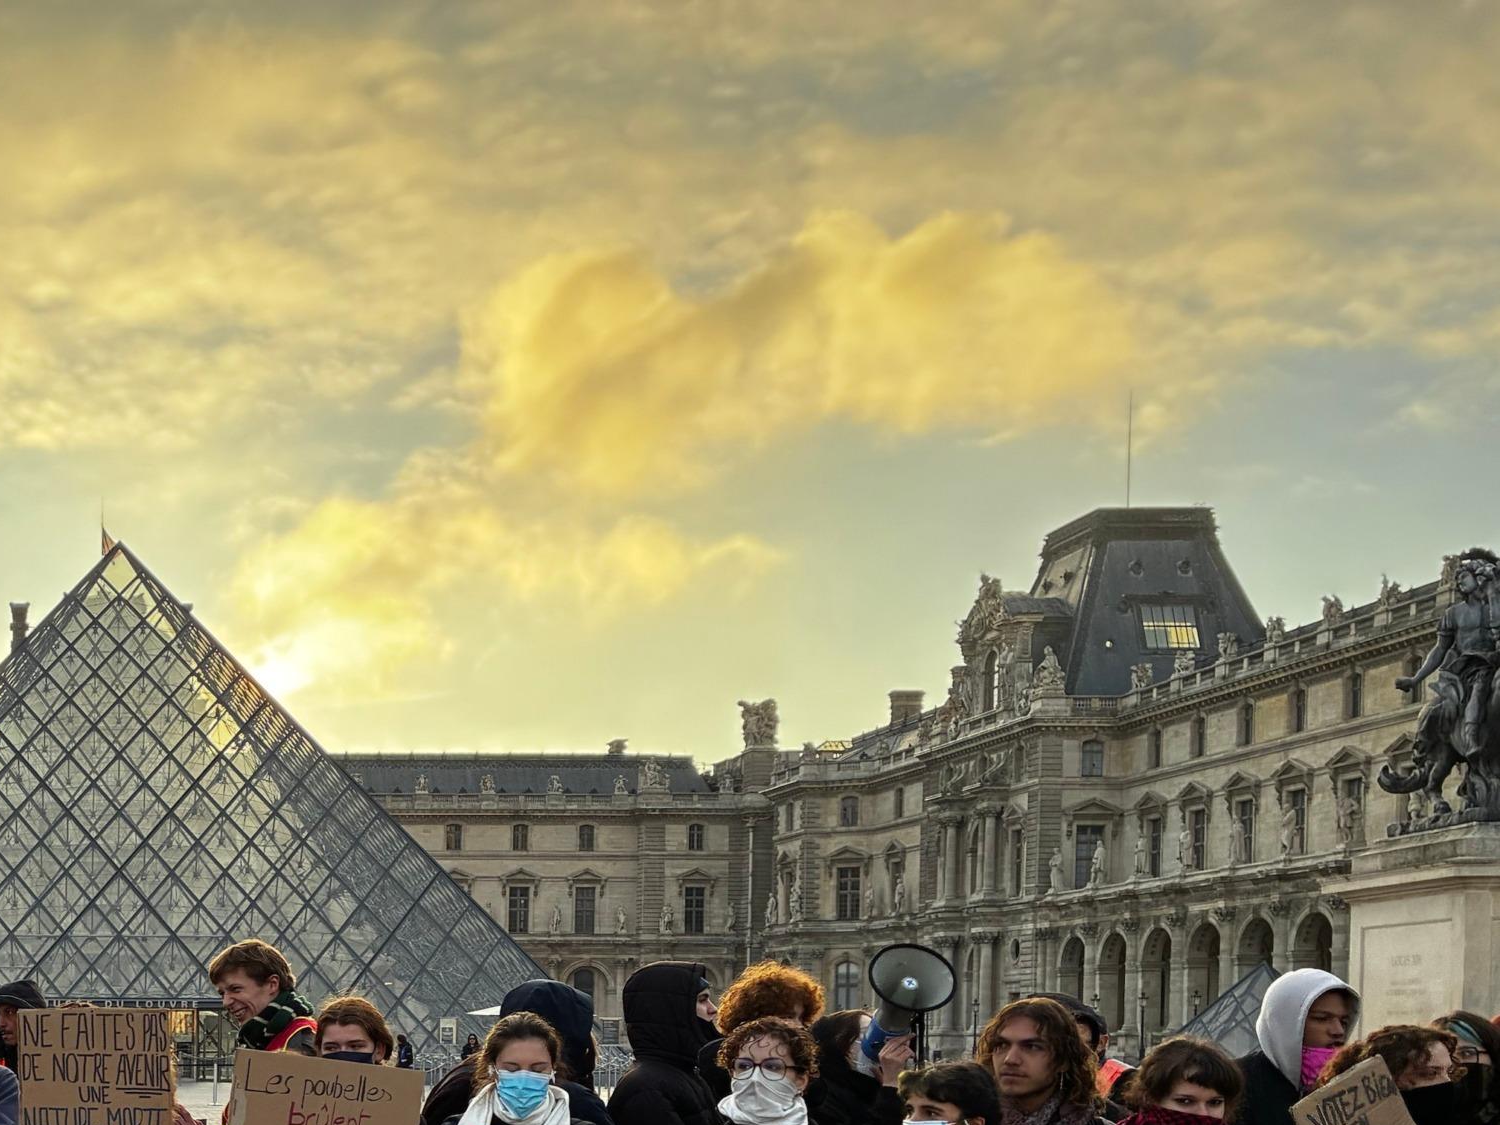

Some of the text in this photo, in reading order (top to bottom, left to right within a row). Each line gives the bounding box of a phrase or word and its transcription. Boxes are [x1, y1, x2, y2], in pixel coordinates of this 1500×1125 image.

[105, 1000, 124, 1008] DU
[136, 1000, 199, 1008] LOUVRE
[22, 1014, 52, 1048] NE
[142, 1011, 168, 1053] PAS
[22, 1053, 45, 1082] DE
[52, 1053, 112, 1085] NOTRE
[244, 1058, 393, 1108] Les poubelles
[78, 1085, 113, 1104] UNE
